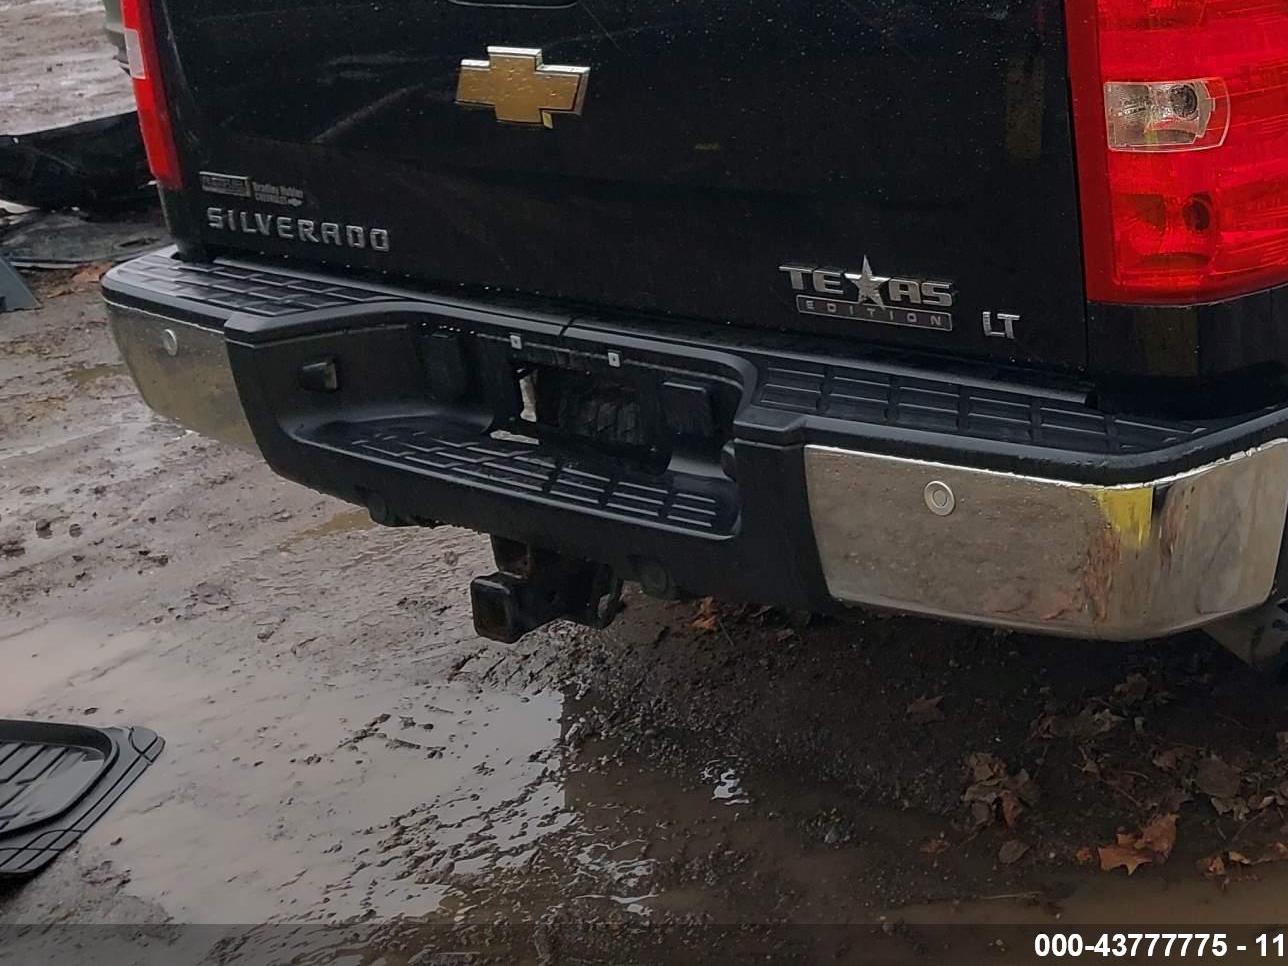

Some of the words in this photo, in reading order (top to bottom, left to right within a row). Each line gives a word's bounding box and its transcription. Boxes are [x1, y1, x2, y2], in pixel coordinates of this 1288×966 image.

[206, 206, 390, 252] SILVERADO
[778, 256, 953, 307] TEXAS
[805, 299, 944, 327] EDITION
[982, 311, 1021, 339] LT
